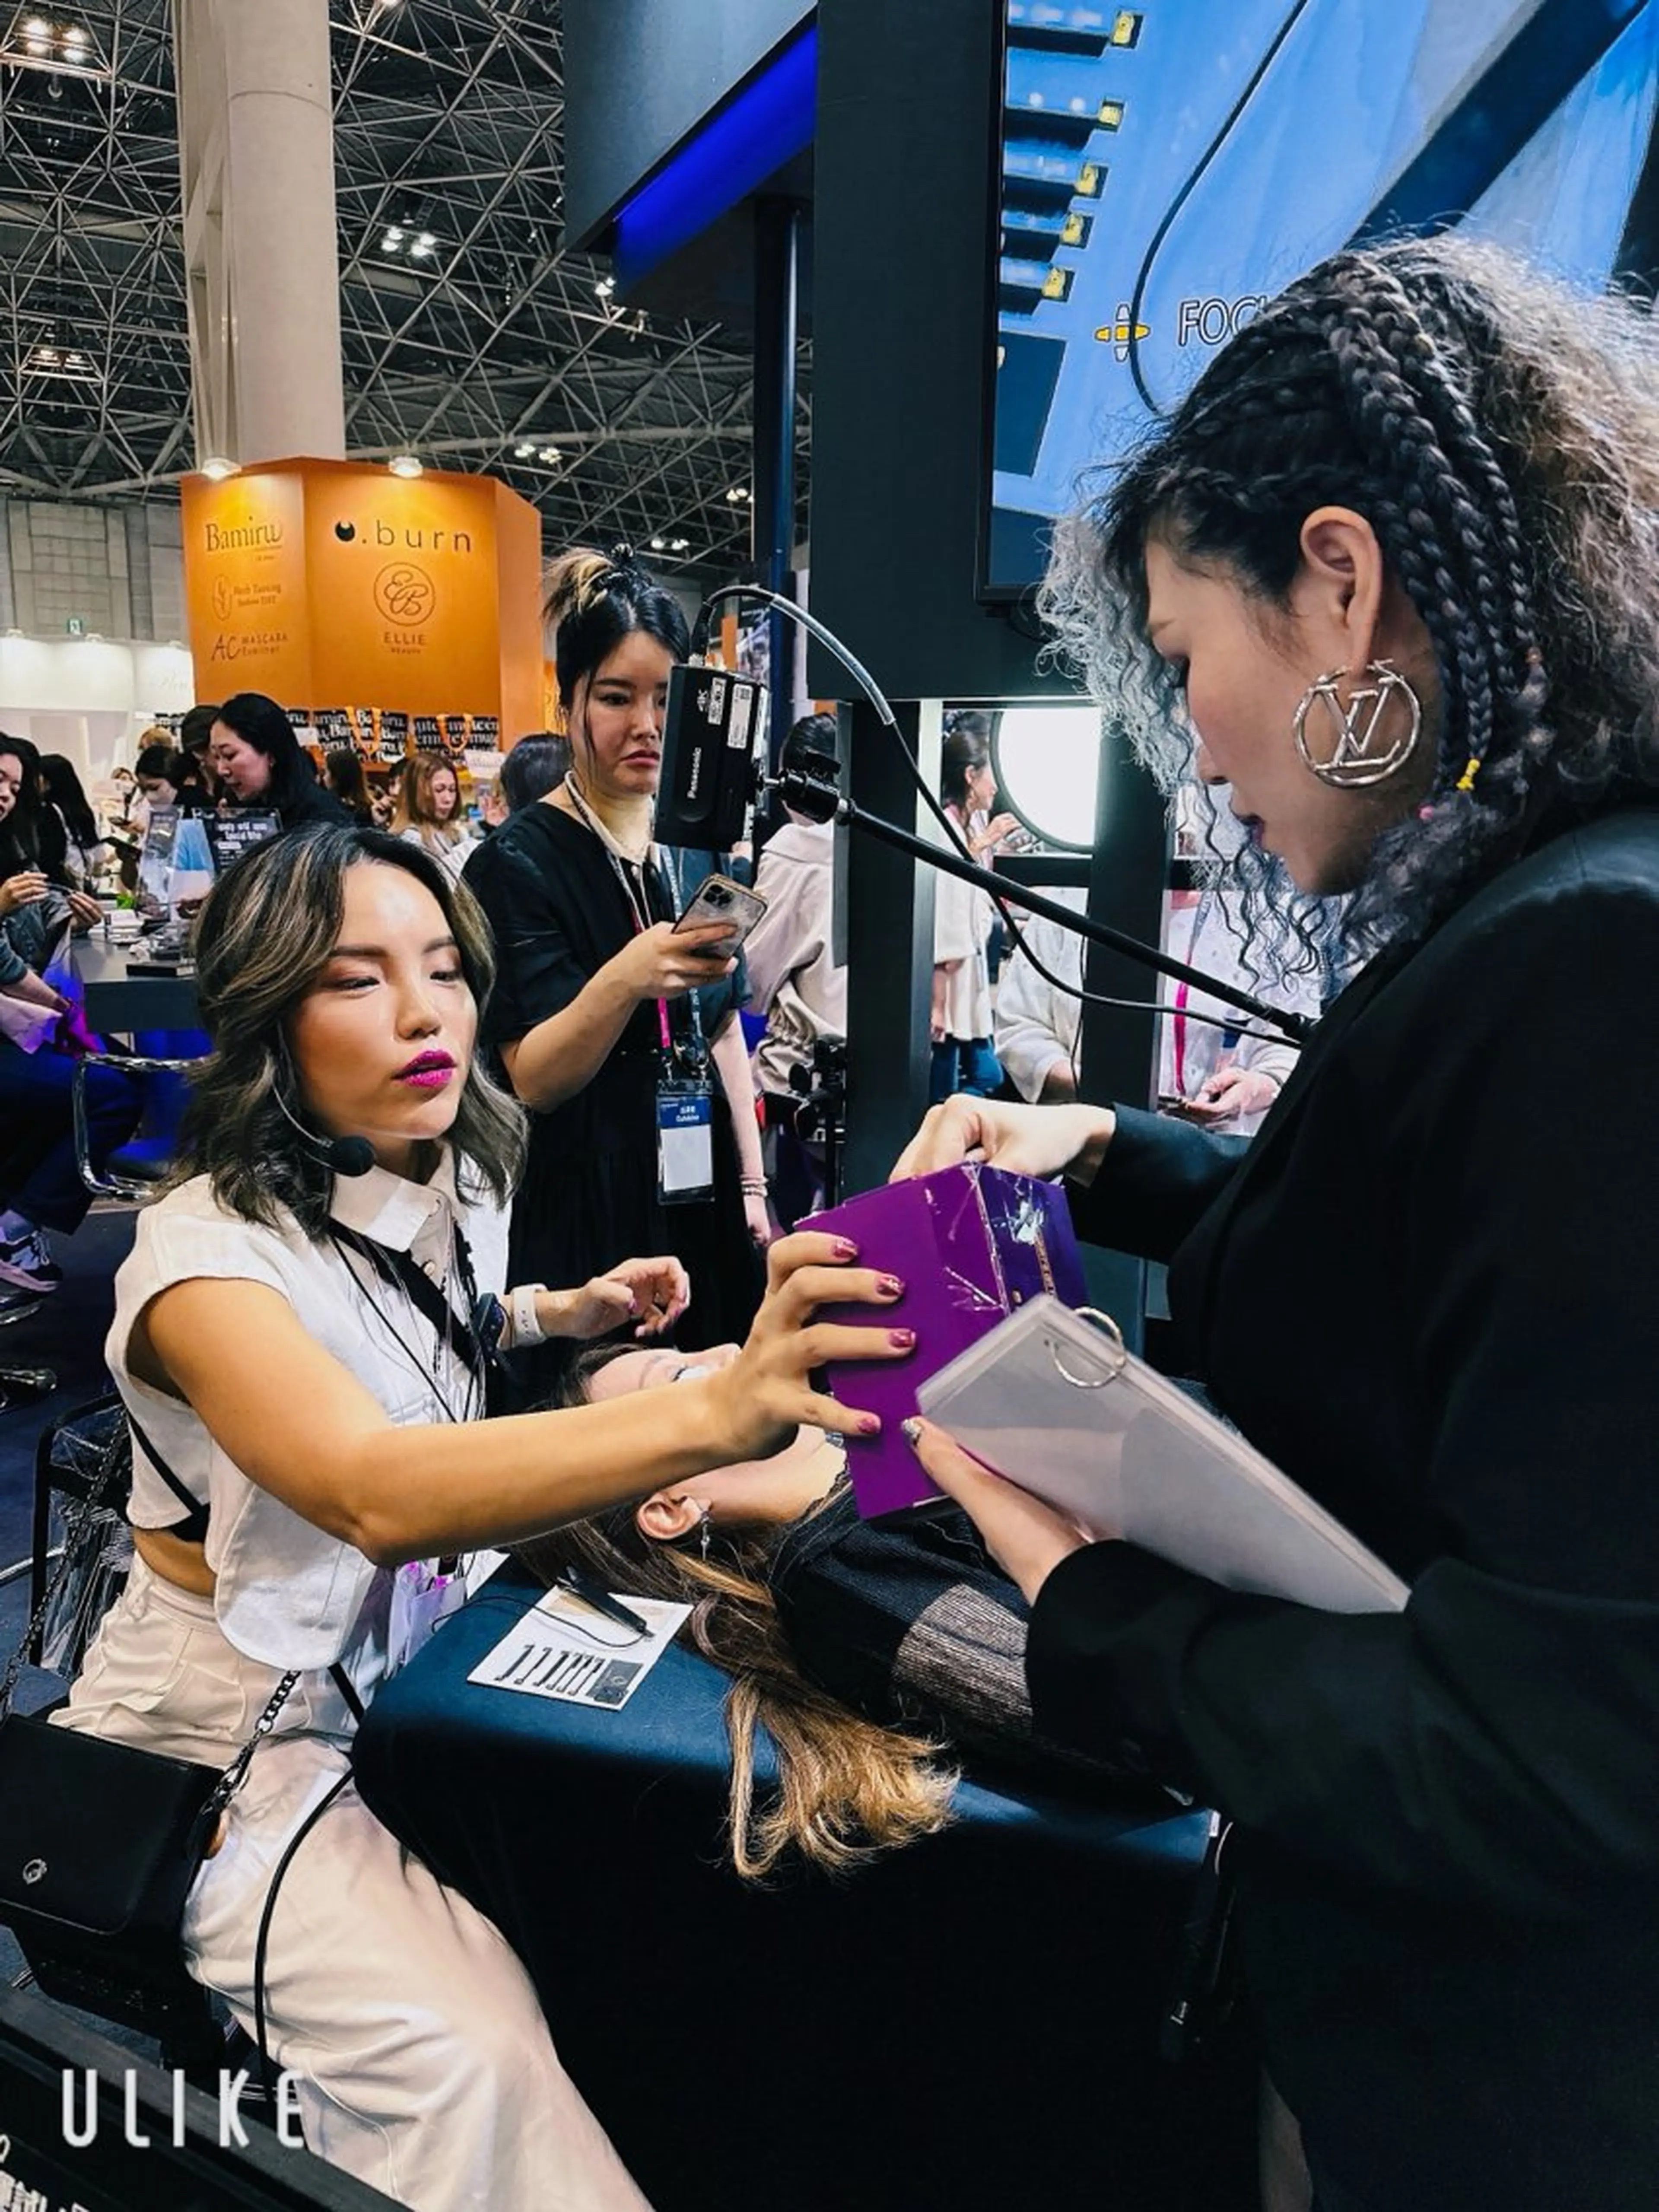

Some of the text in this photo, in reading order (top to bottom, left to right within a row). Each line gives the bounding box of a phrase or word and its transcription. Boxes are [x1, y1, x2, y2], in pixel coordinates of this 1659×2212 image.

[1178, 296, 1268, 346] FOC
[384, 631, 426, 646] ELLIE
[687, 747, 702, 799] Panasonic
